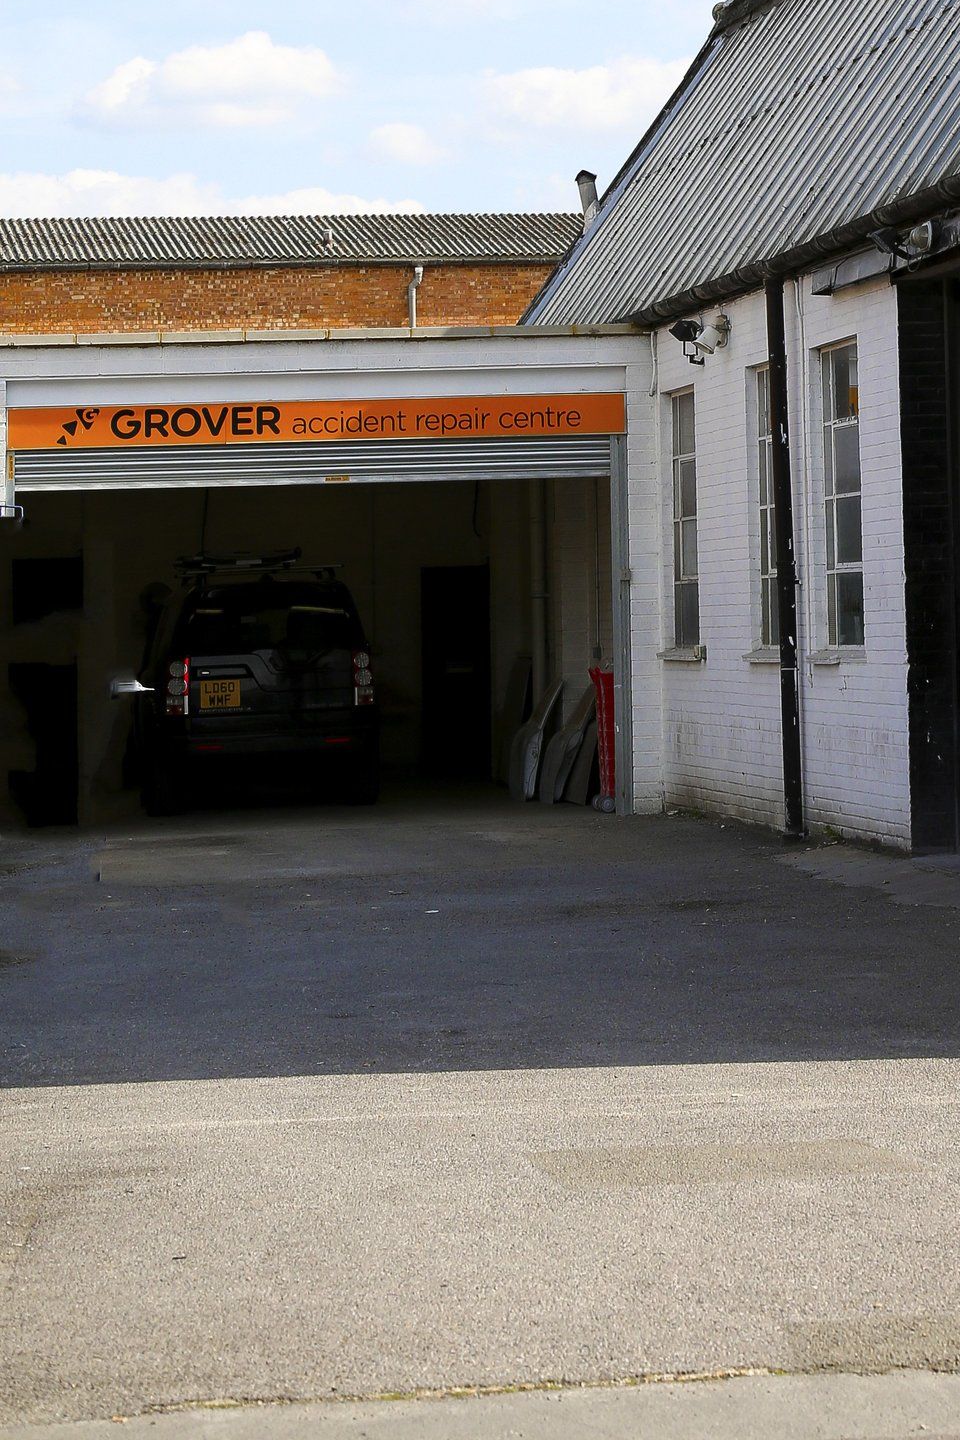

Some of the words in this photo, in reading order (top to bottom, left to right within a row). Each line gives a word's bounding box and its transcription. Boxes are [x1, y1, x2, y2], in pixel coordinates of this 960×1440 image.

[110, 406, 281, 439] GROVER
[292, 410, 406, 435] accident
[415, 407, 490, 435] repair
[498, 406, 581, 430] centre
[204, 681, 236, 694] LD60
[208, 695, 232, 707] WMF
